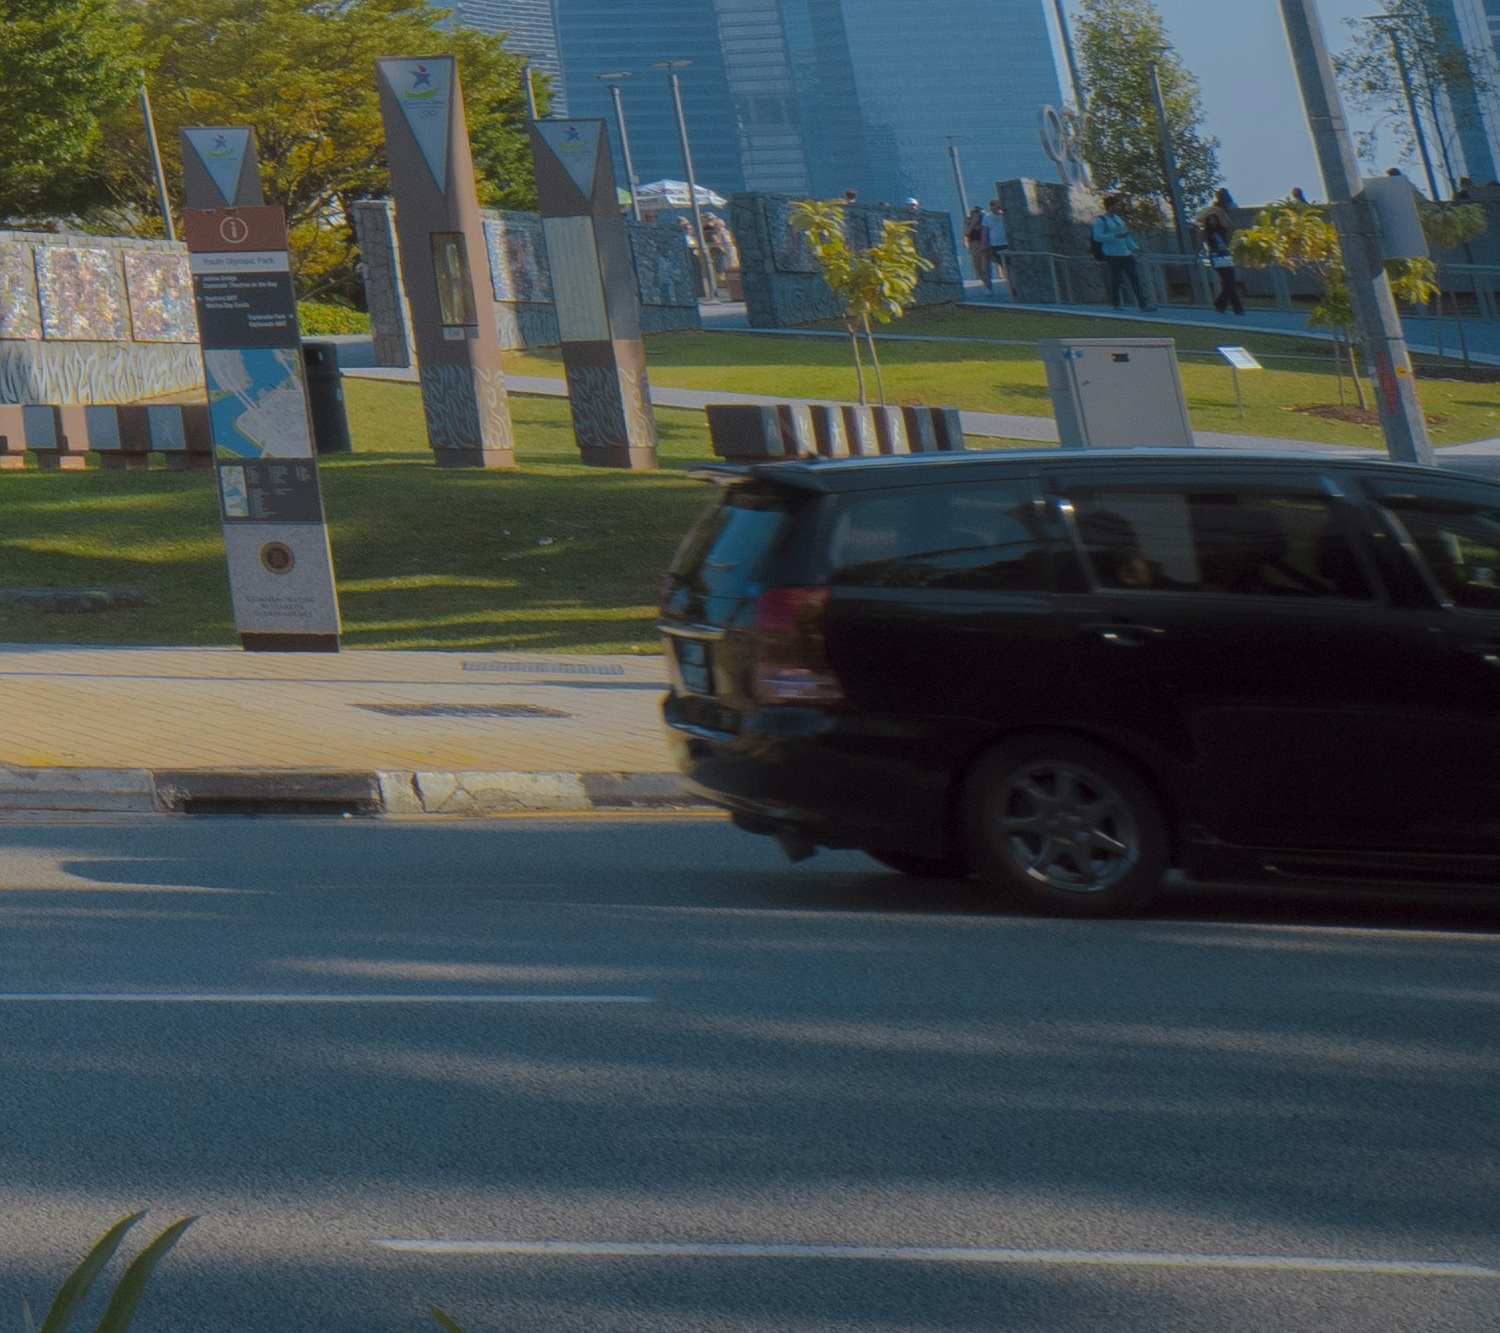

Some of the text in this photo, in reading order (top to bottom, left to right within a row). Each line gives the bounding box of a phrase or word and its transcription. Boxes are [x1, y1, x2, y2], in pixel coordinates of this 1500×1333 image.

[203, 256, 275, 266] Youth Olympic Park
